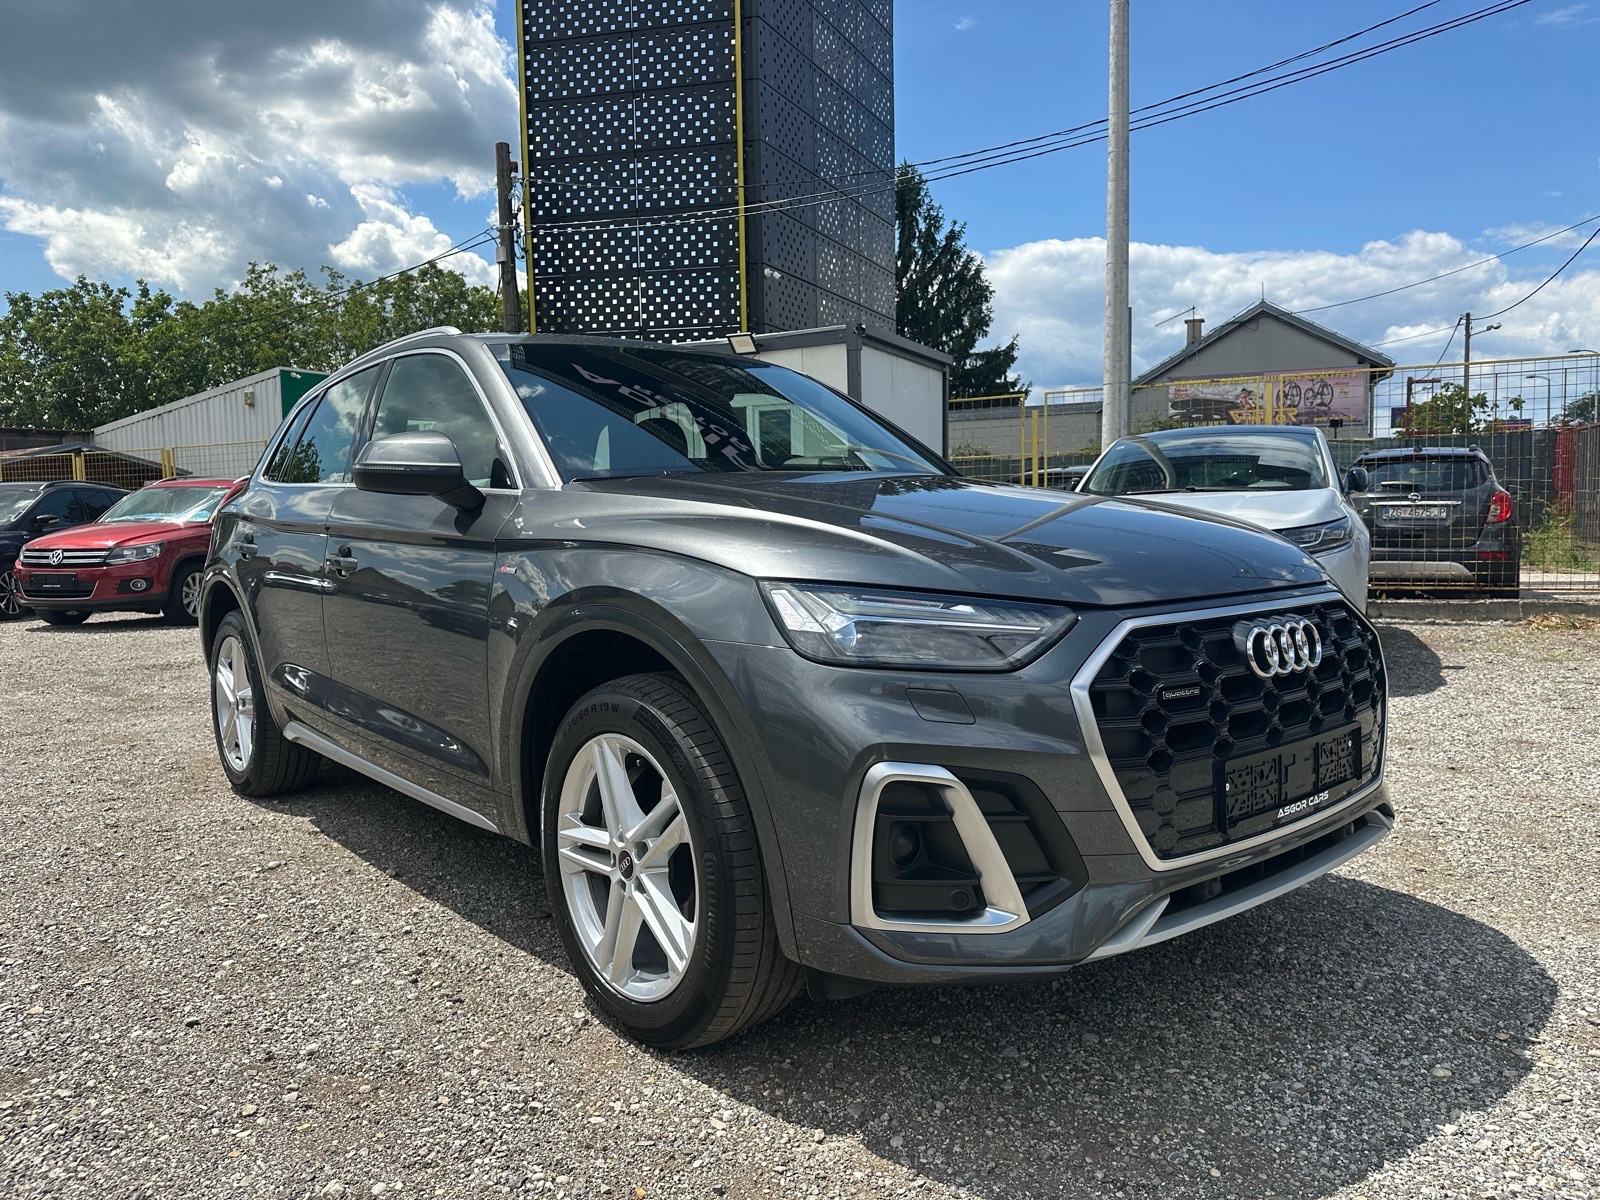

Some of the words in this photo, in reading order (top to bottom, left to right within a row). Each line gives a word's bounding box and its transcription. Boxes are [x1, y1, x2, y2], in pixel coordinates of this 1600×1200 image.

[1390, 507, 1402, 517] ZG
[1165, 688, 1200, 698] quattro
[599, 702, 609, 712] 19
[611, 703, 620, 713] W
[1277, 799, 1307, 818] ASGOR
[1308, 790, 1329, 806] CARS
